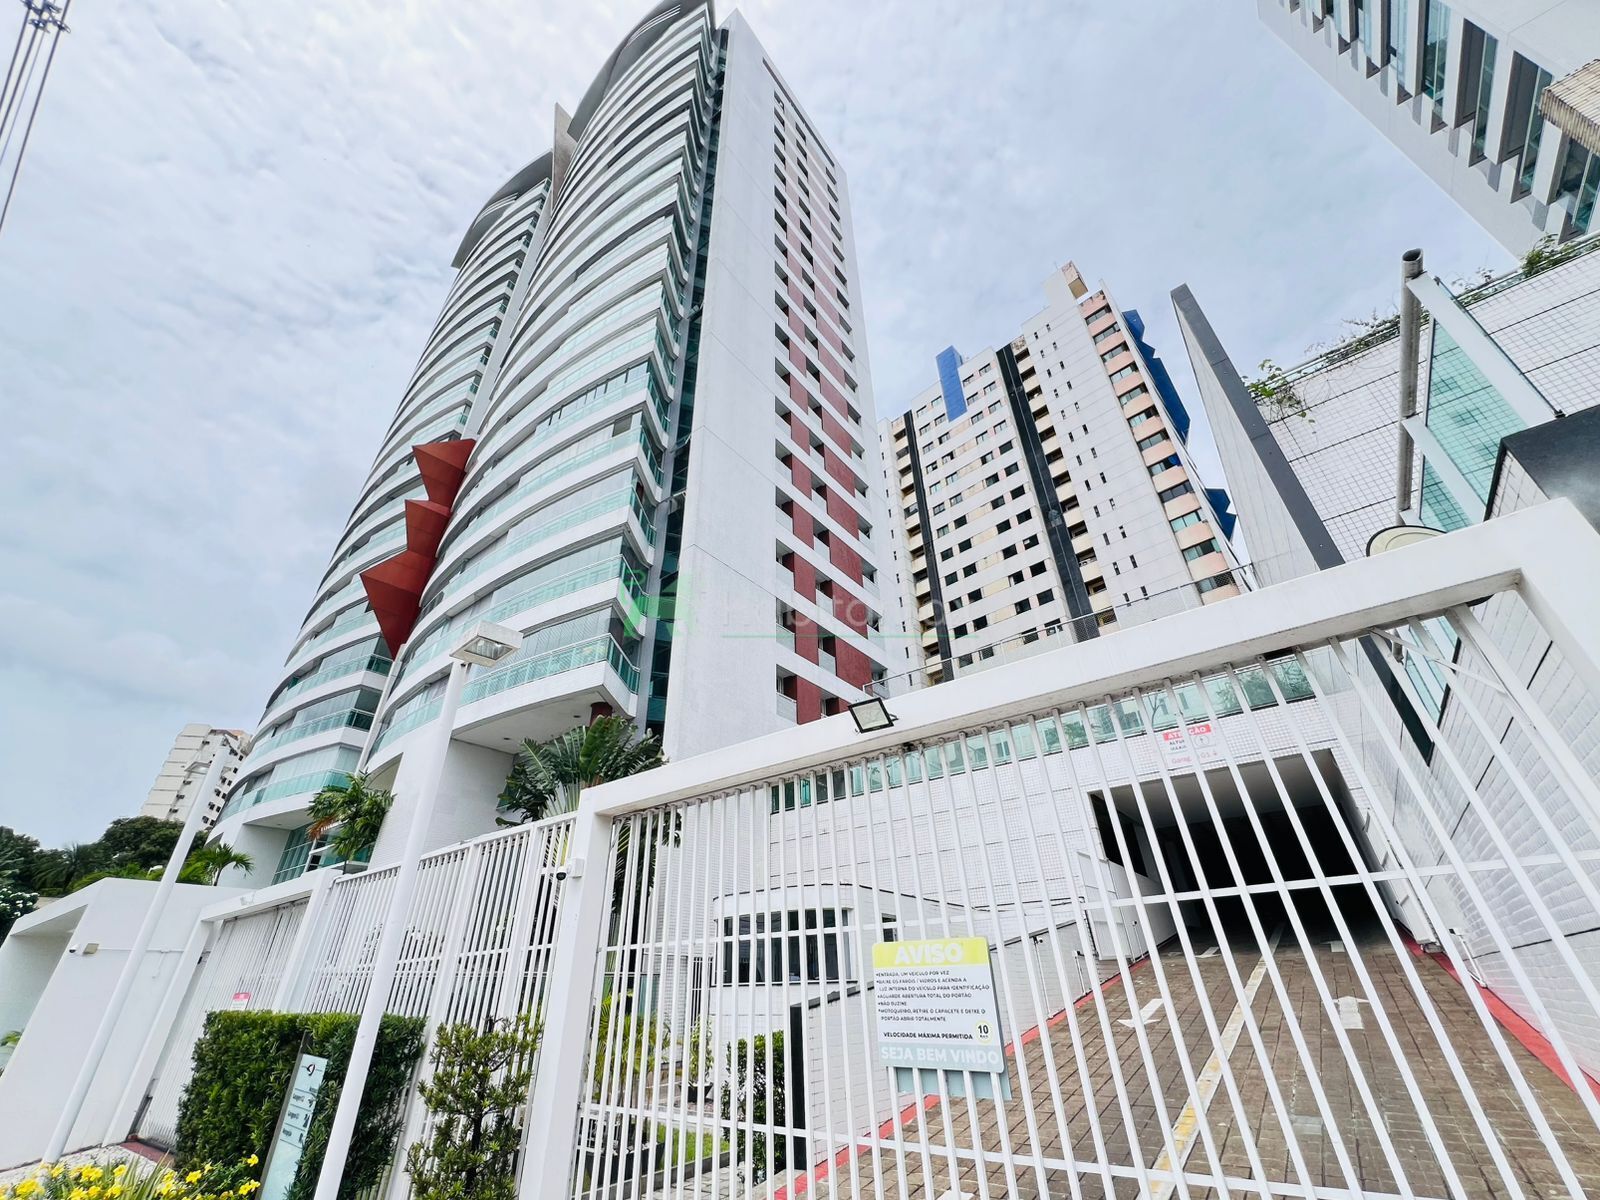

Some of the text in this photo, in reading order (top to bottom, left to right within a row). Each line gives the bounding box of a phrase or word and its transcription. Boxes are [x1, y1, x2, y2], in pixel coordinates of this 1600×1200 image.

[895, 943, 963, 964] AVISO
[978, 1024, 989, 1034] 10
[881, 1046, 999, 1064] SEJA BEM VINDO
